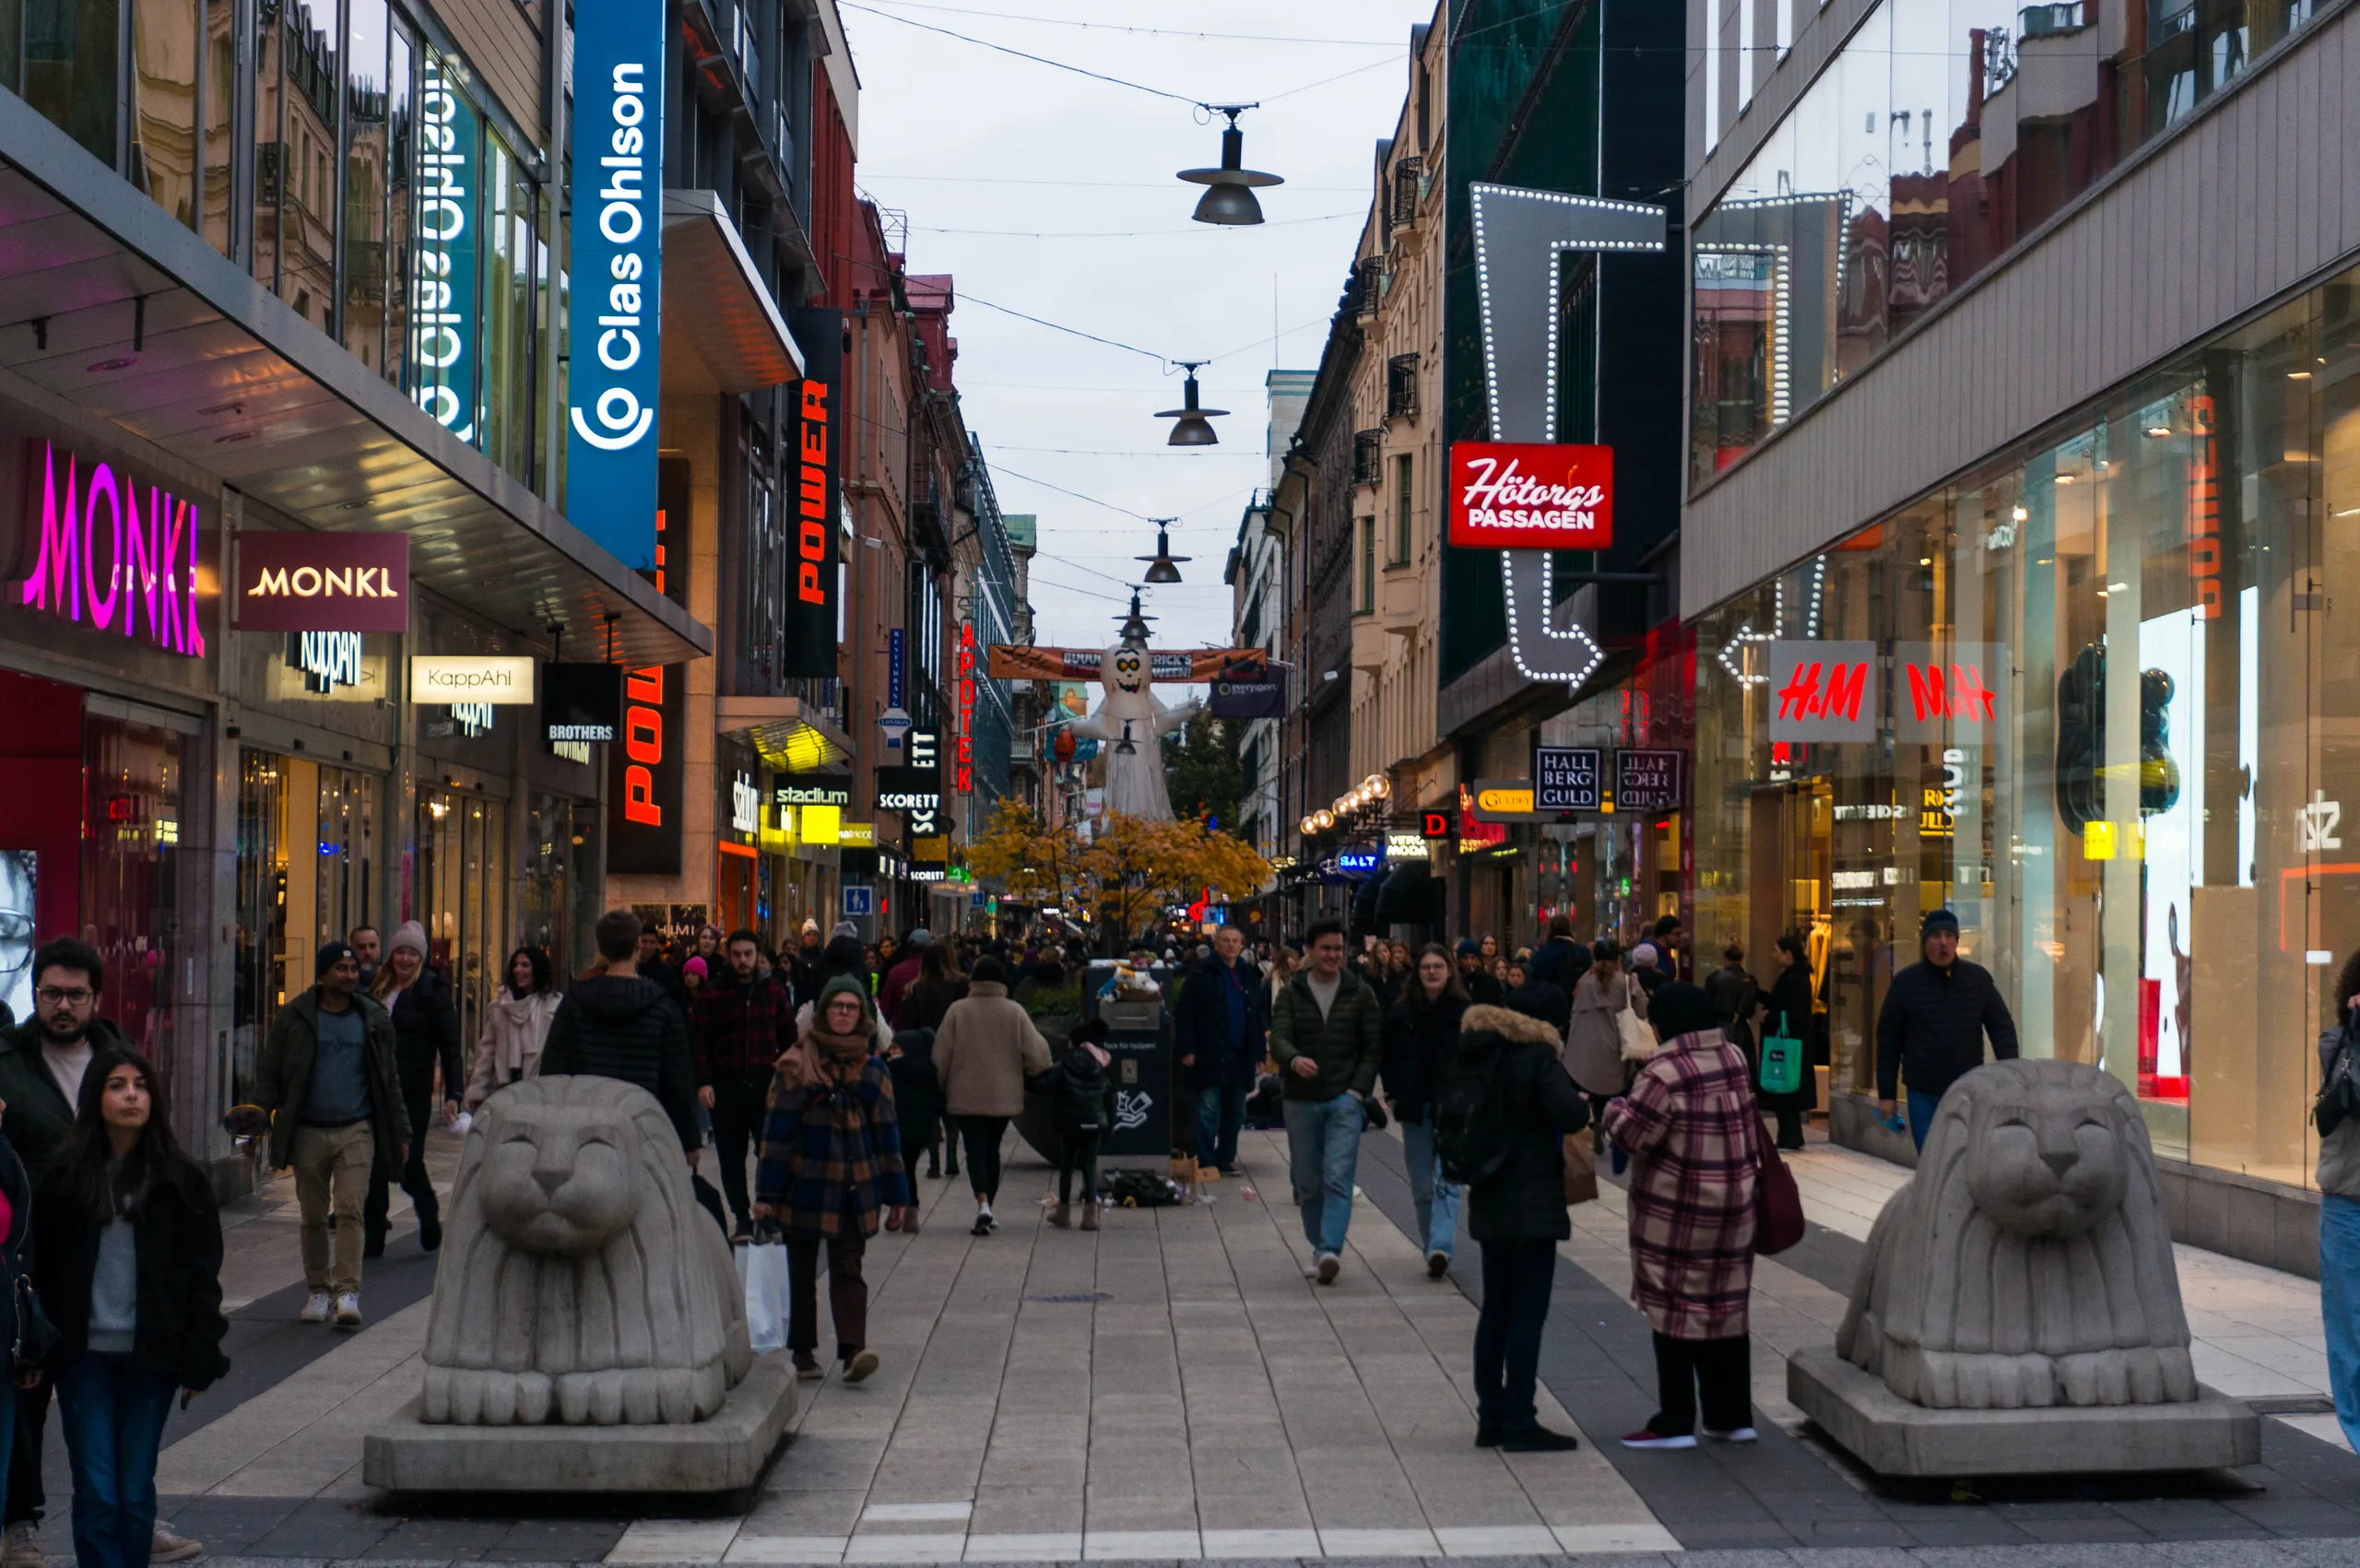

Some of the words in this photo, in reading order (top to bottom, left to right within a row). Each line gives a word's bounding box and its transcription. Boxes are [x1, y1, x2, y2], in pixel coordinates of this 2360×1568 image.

[599, 62, 644, 244] Ohlson
[597, 252, 642, 371] Clas
[798, 379, 828, 605] POWER
[1463, 458, 1604, 511] Hötorgs
[1469, 508, 1595, 530] PASSAGEN
[23, 436, 205, 659] MONKI
[247, 565, 399, 598] MONKI
[429, 669, 512, 690] KappAhl
[1151, 666, 1192, 679] WEEN!
[1777, 662, 1869, 722] H&M
[959, 624, 975, 793] APOTEK
[549, 725, 613, 740] BROTHERS
[1544, 755, 1592, 771] HALL
[776, 786, 848, 804] stadium
[879, 794, 939, 808] SCORETT
[1542, 789, 1593, 805] GULD
[1426, 813, 1447, 835] D
[1386, 844, 1428, 856] MODA
[1339, 855, 1376, 867] SALT
[910, 870, 945, 881] SCORETT
